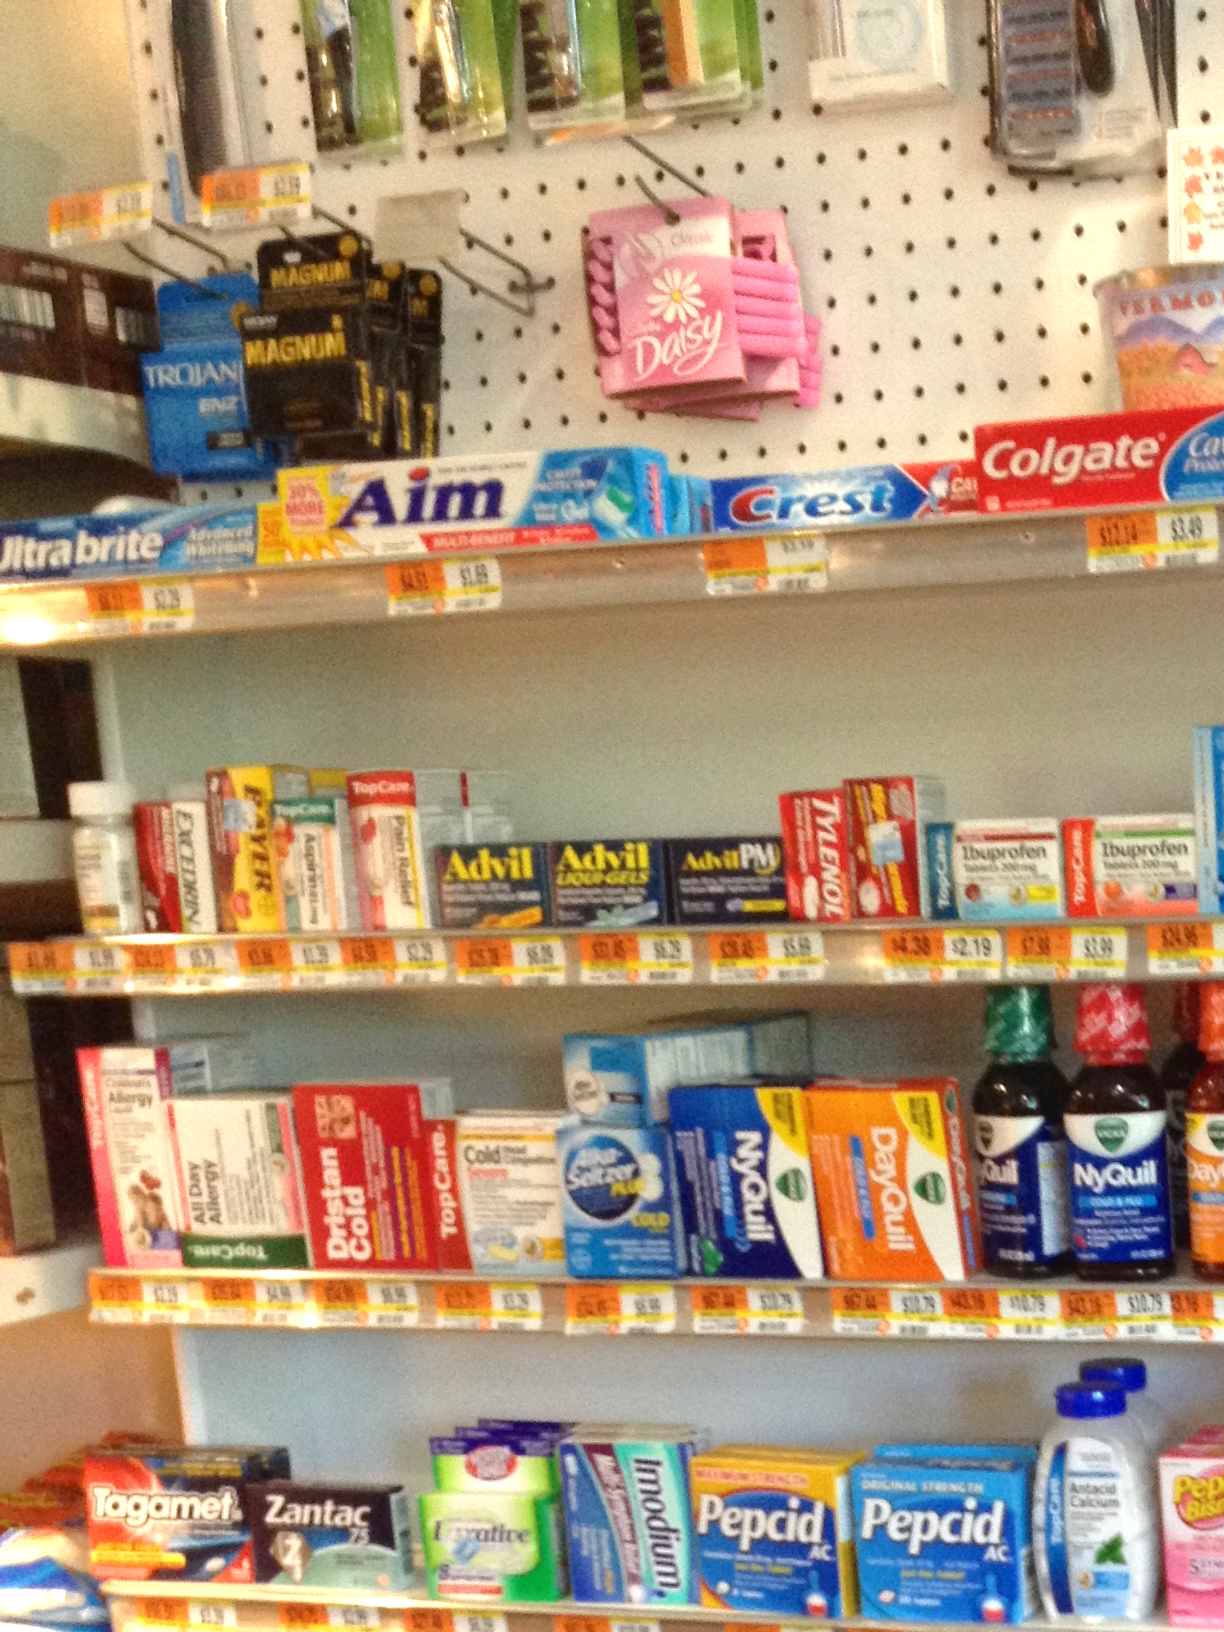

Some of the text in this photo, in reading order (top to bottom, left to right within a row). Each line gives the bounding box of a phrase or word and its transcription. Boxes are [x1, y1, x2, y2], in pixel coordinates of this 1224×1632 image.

[269, 259, 351, 289] MAGNUM
[244, 332, 346, 368] MAGNUM
[632, 311, 725, 382] Daisy
[144, 361, 242, 388] TROJAN
[982, 433, 1161, 486] Colgate
[337, 466, 504, 528] Aim
[730, 482, 895, 525] Crest
[174, 810, 203, 926] EXCEDRIN
[443, 846, 534, 881] Advil
[555, 840, 651, 873] Advil
[684, 842, 776, 873] Advil PM
[811, 796, 844, 921] TYLENOL
[961, 843, 1047, 863] Ibuprofen
[1074, 826, 1089, 905] TopCare
[1100, 840, 1189, 861] Ibuprofen
[951, 936, 993, 960] $2.19
[463, 1143, 501, 1165] Cold
[431, 1124, 459, 1238] TopCare
[730, 1129, 776, 1244] NyQuil
[869, 1125, 915, 1252] DayQuil
[1073, 1159, 1158, 1190] NyQuil
[319, 1146, 350, 1261] Dristan
[345, 1186, 373, 1262] Cold
[91, 1484, 242, 1526] Tagamet
[922, 1480, 984, 1495] STRENGTH
[1069, 1482, 1117, 1497] Antacid
[1069, 1495, 1122, 1511] Calcium
[265, 1495, 371, 1528] Zantac
[633, 1456, 682, 1591] Imodium
[696, 1493, 825, 1552] Pepcid
[861, 1495, 1005, 1556] Pepcid
[808, 1544, 832, 1562] AC
[983, 1544, 1009, 1562] AC
